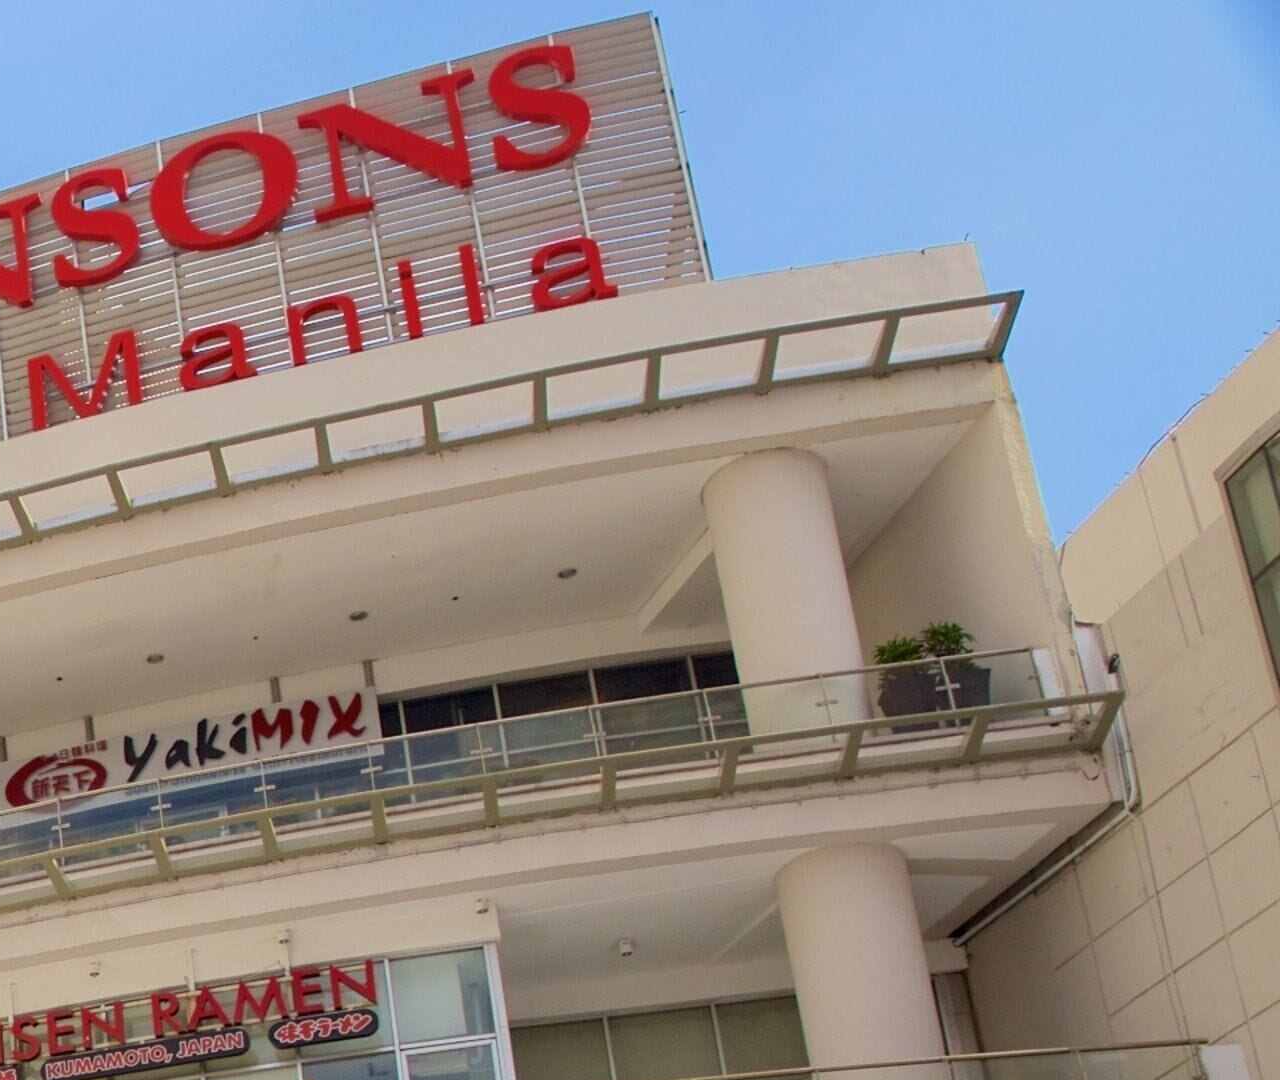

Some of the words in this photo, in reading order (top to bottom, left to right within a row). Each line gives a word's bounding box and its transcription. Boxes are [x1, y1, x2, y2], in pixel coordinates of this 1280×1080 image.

[27, 237, 619, 432] Manila
[148, 959, 379, 1040] RAMEN
[45, 1044, 174, 1080] KUMAMOTO,
[176, 1031, 245, 1059] JAPAN
